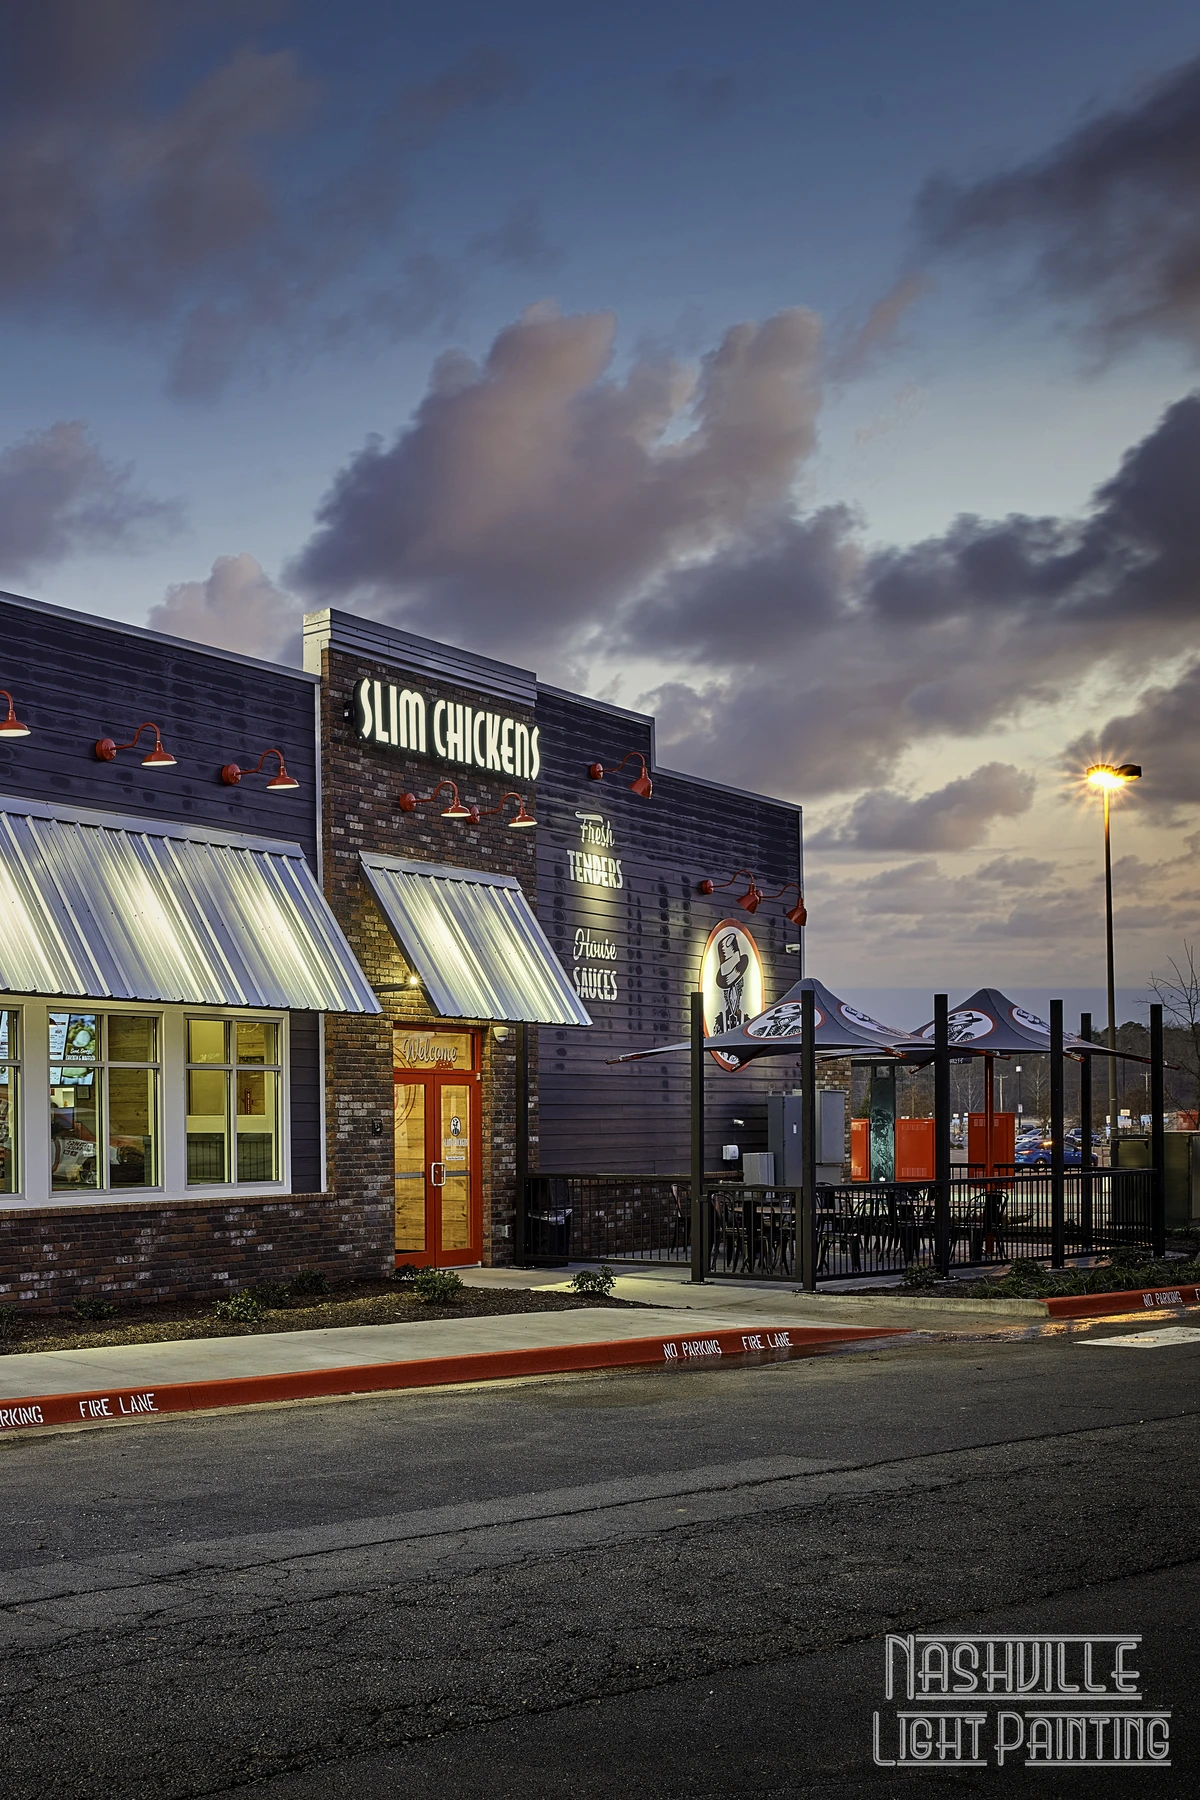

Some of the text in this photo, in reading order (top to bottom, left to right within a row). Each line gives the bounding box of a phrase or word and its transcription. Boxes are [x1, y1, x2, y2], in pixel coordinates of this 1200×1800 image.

[360, 677, 540, 781] SLIM CHICKENS
[574, 811, 616, 848] Fresh
[566, 849, 624, 889] TENDERS
[573, 928, 618, 961] House
[573, 966, 618, 1001] SAUCES
[402, 1038, 459, 1063] Welcome
[1142, 1293, 1154, 1308] NO
[1155, 1290, 1183, 1305] PARKING
[663, 1331, 794, 1360] NO PARKING FIRE LANE
[79, 1398, 113, 1418] FIRE
[118, 1393, 159, 1414] LANE
